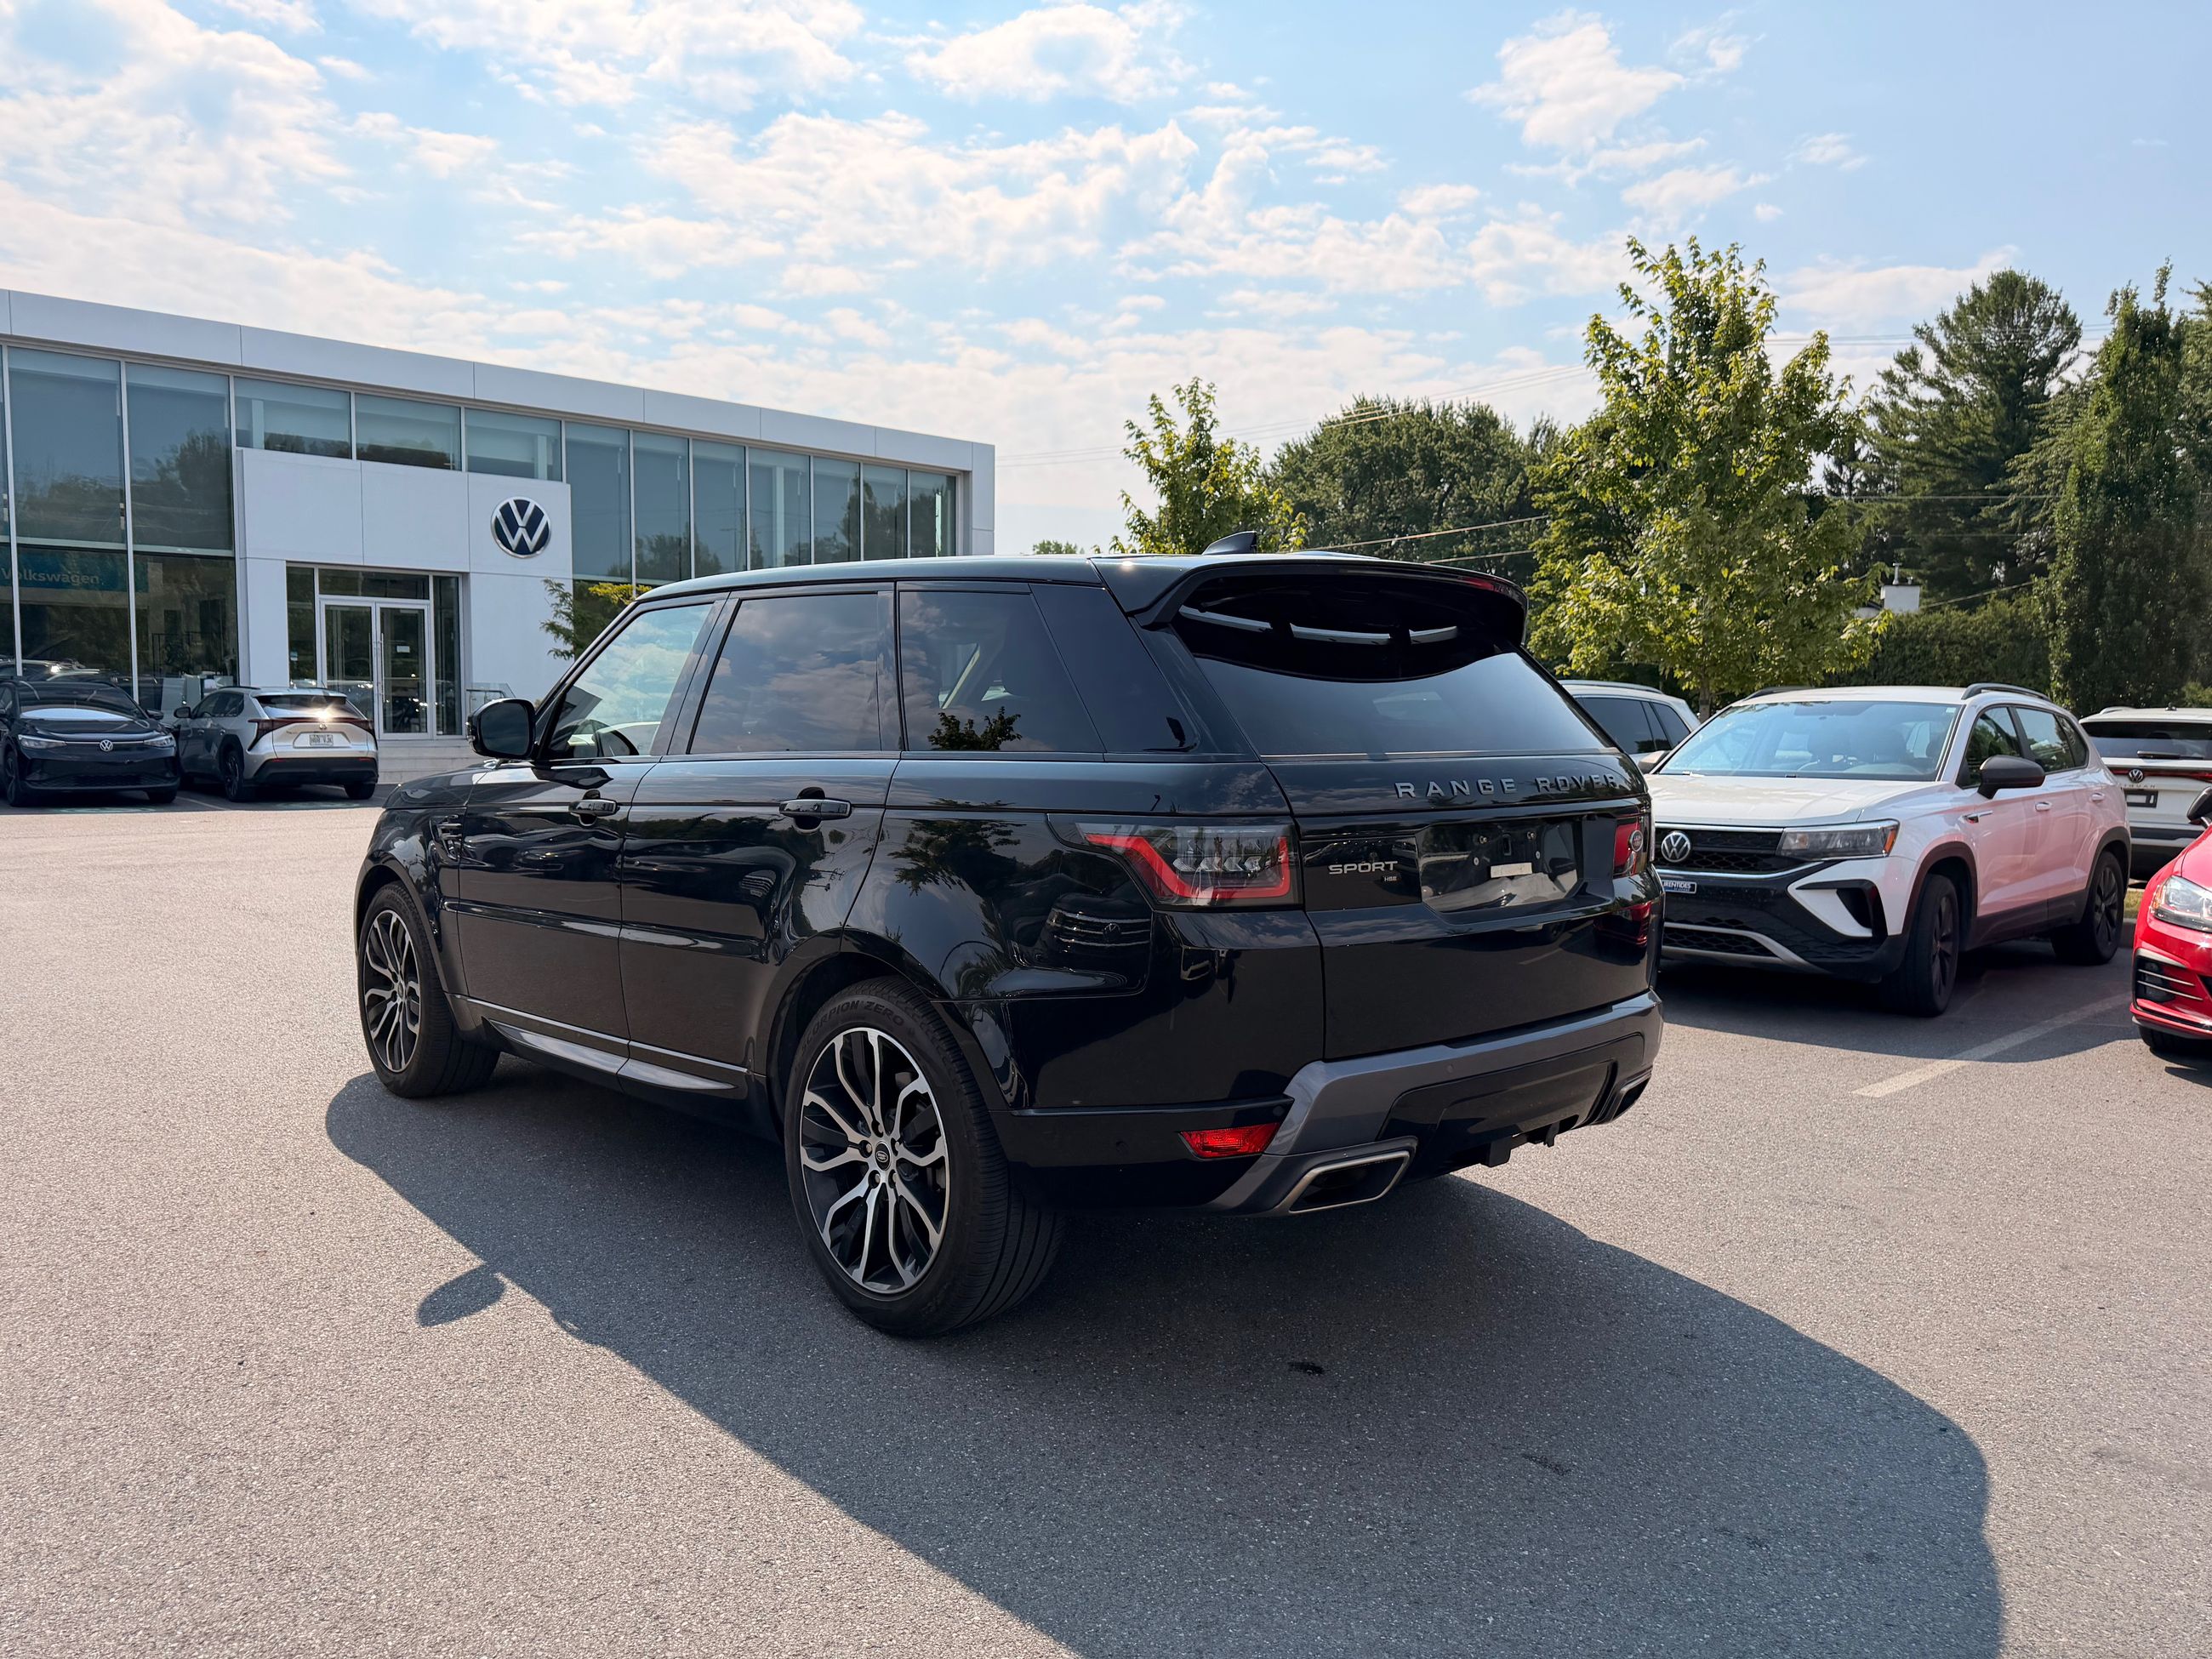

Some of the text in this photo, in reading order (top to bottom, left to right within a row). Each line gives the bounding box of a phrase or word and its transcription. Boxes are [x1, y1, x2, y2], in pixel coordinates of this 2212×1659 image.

[492, 497, 550, 557] VW
[1394, 773, 1618, 799] RANGE ROVER
[1662, 831, 1690, 862] VW
[1328, 861, 1399, 875] SPORT
[864, 1001, 904, 1026] ZERO
